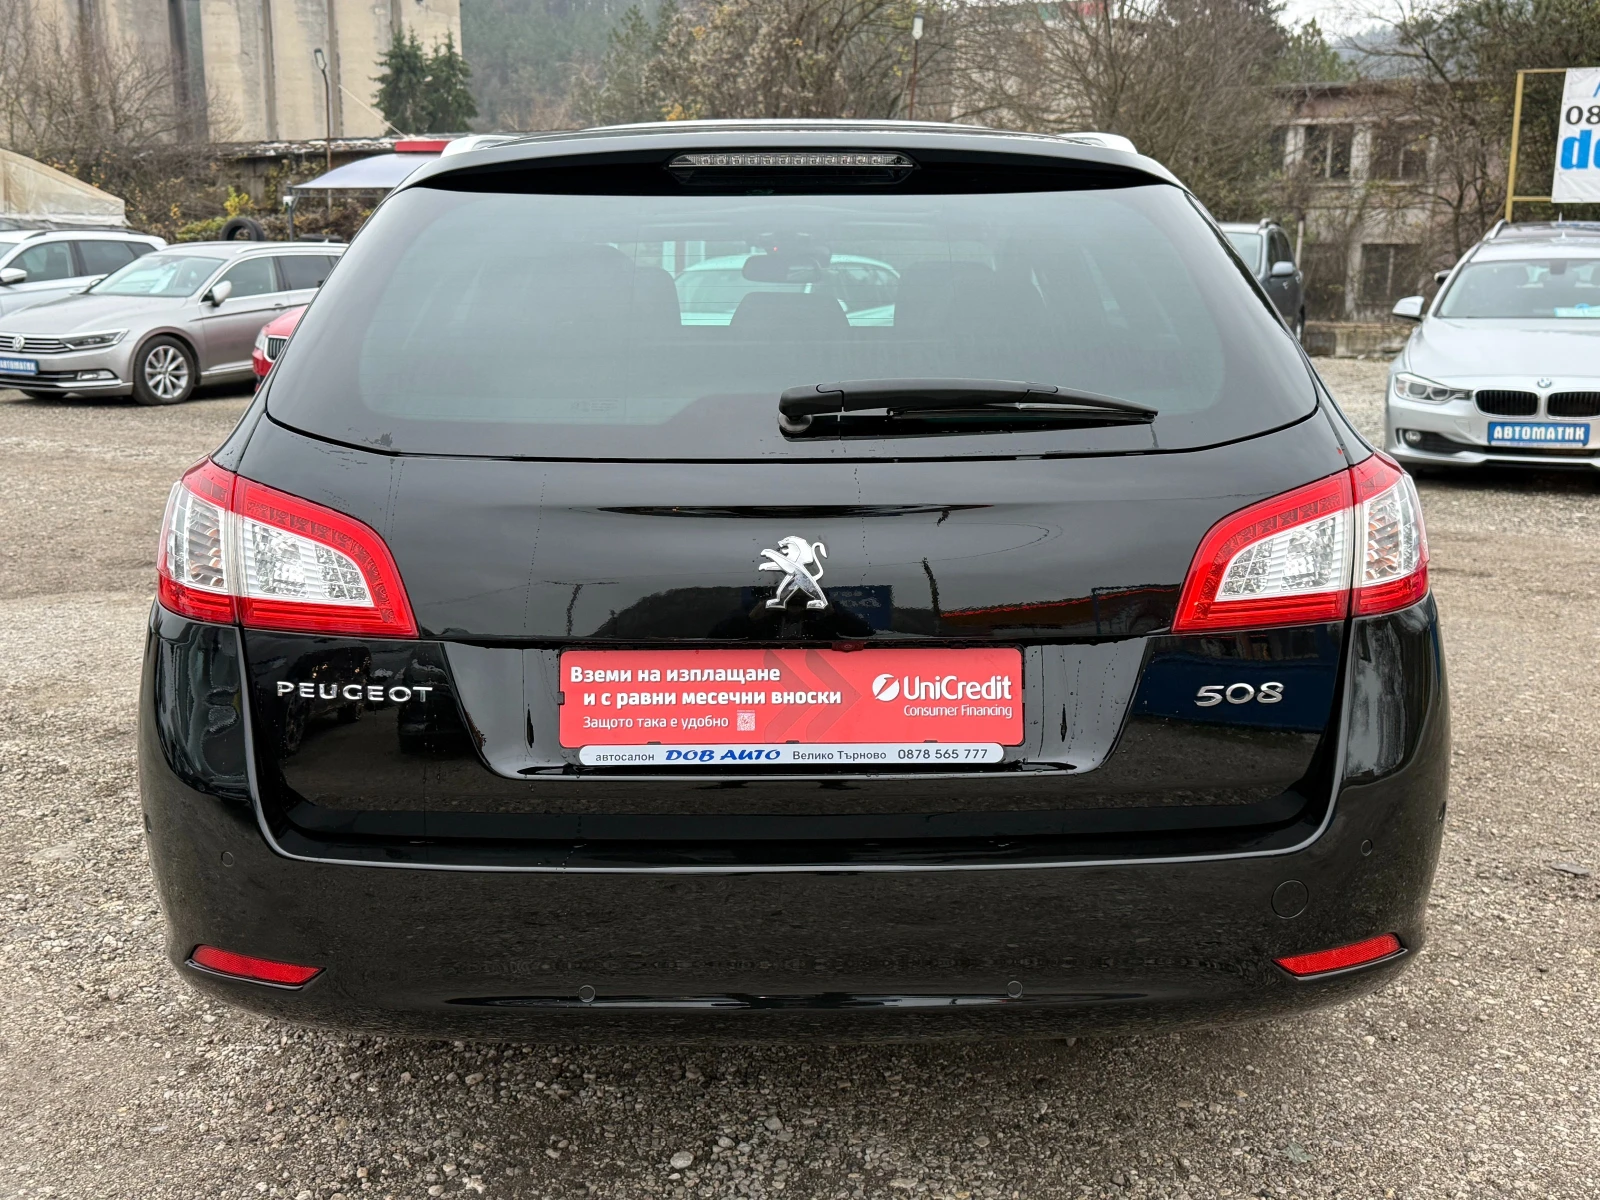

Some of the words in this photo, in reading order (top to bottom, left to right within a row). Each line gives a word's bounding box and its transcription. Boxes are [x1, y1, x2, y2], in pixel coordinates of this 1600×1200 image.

[1493, 425, 1585, 441] АВТОМАТИК
[570, 666, 632, 683] Вземи
[637, 669, 662, 683] на
[666, 668, 781, 685] изплащане
[276, 681, 433, 703] PEUGEOT
[903, 675, 1012, 700] UniCredit
[1194, 681, 1284, 707] 508
[583, 692, 596, 706] и
[601, 693, 612, 706] с
[616, 692, 676, 709] равни
[682, 691, 766, 706] месечни
[771, 690, 842, 705] вноски
[903, 704, 958, 718] Consumer
[961, 704, 1013, 719] Financing
[583, 716, 634, 730] Защото
[637, 717, 667, 729] така
[670, 717, 678, 728] е
[681, 715, 729, 730] удобно
[595, 752, 655, 762] автосалон
[665, 749, 715, 762] DOB
[720, 749, 781, 761] AUTO
[792, 750, 834, 761] Велико
[837, 750, 887, 762] Търново
[897, 749, 931, 760] 0878
[935, 749, 959, 760] 565
[964, 748, 988, 759] 777
